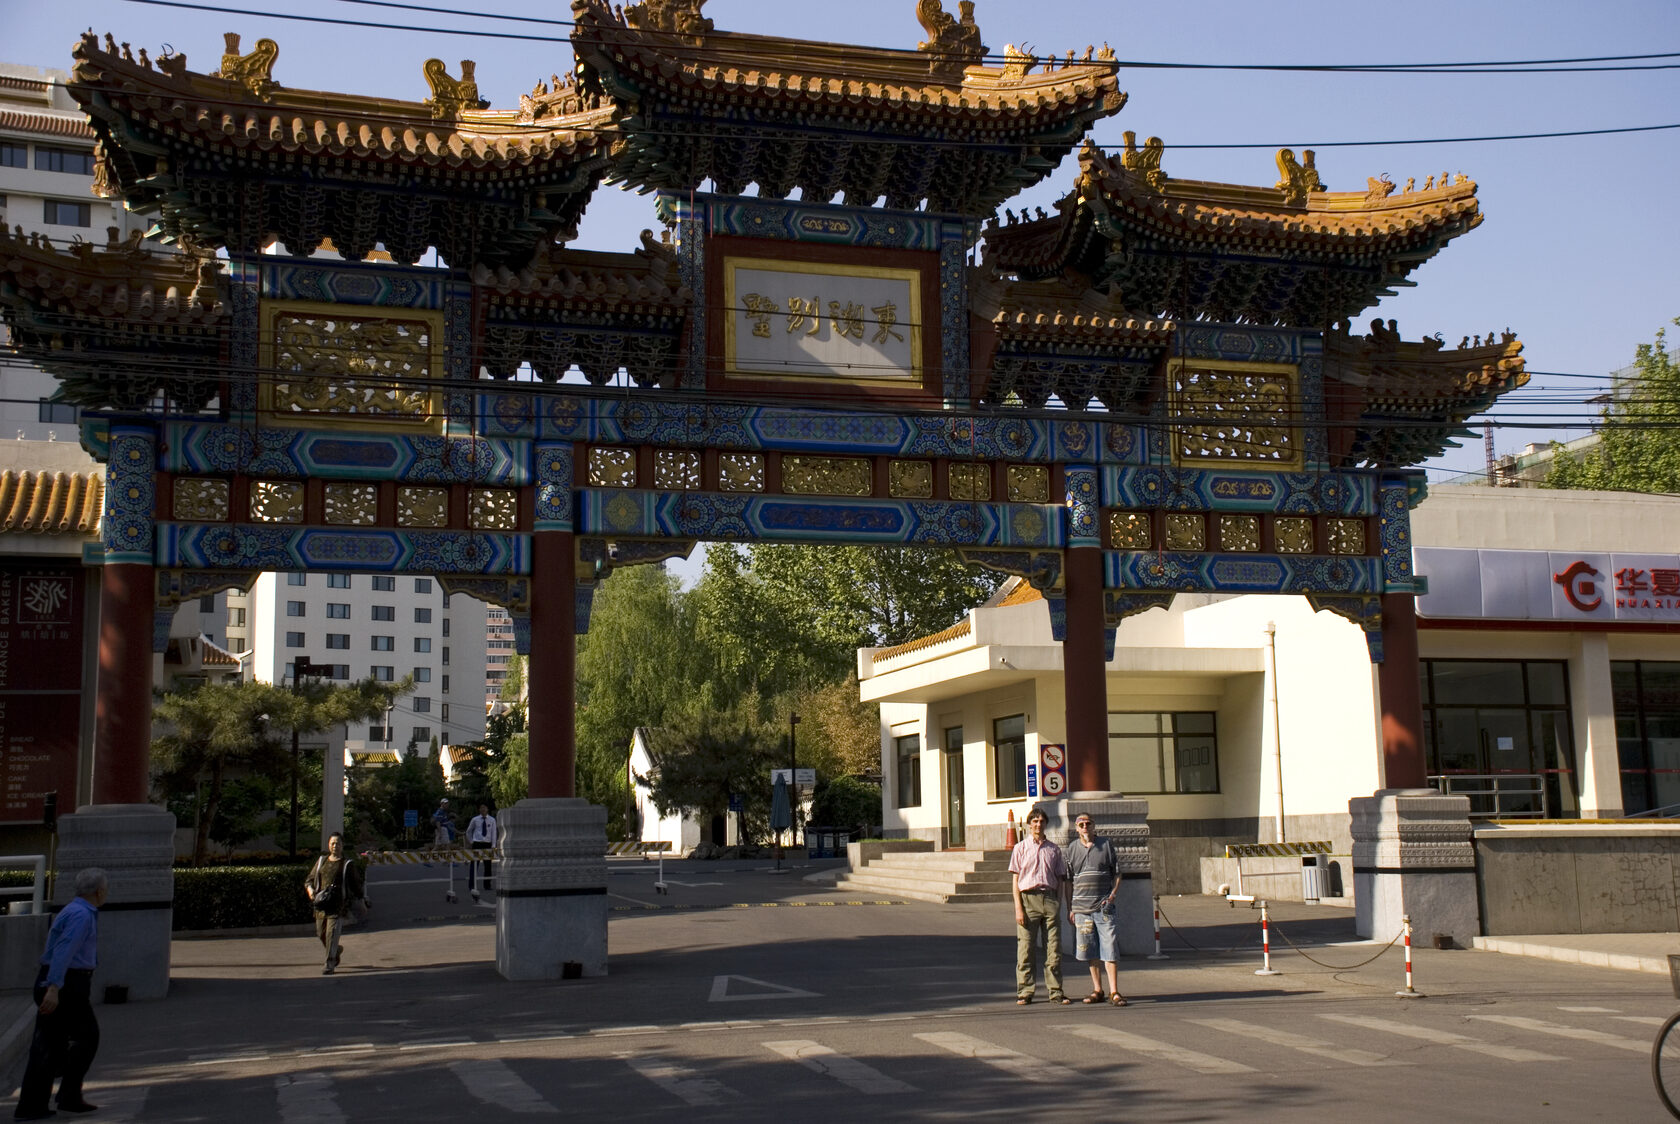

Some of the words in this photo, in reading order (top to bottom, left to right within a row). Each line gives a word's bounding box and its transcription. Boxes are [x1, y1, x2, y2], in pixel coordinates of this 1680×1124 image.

[1614, 568, 1680, 596] 华夏
[0, 571, 12, 625] BAKERY
[0, 631, 9, 687] FRANCE
[8, 754, 51, 762] CHOCOLATE
[1050, 776, 1059, 790] 5
[420, 853, 431, 861] NO
[432, 852, 457, 861] ENTRY
[1233, 847, 1244, 856] NO
[1245, 845, 1269, 855] ENTRY
